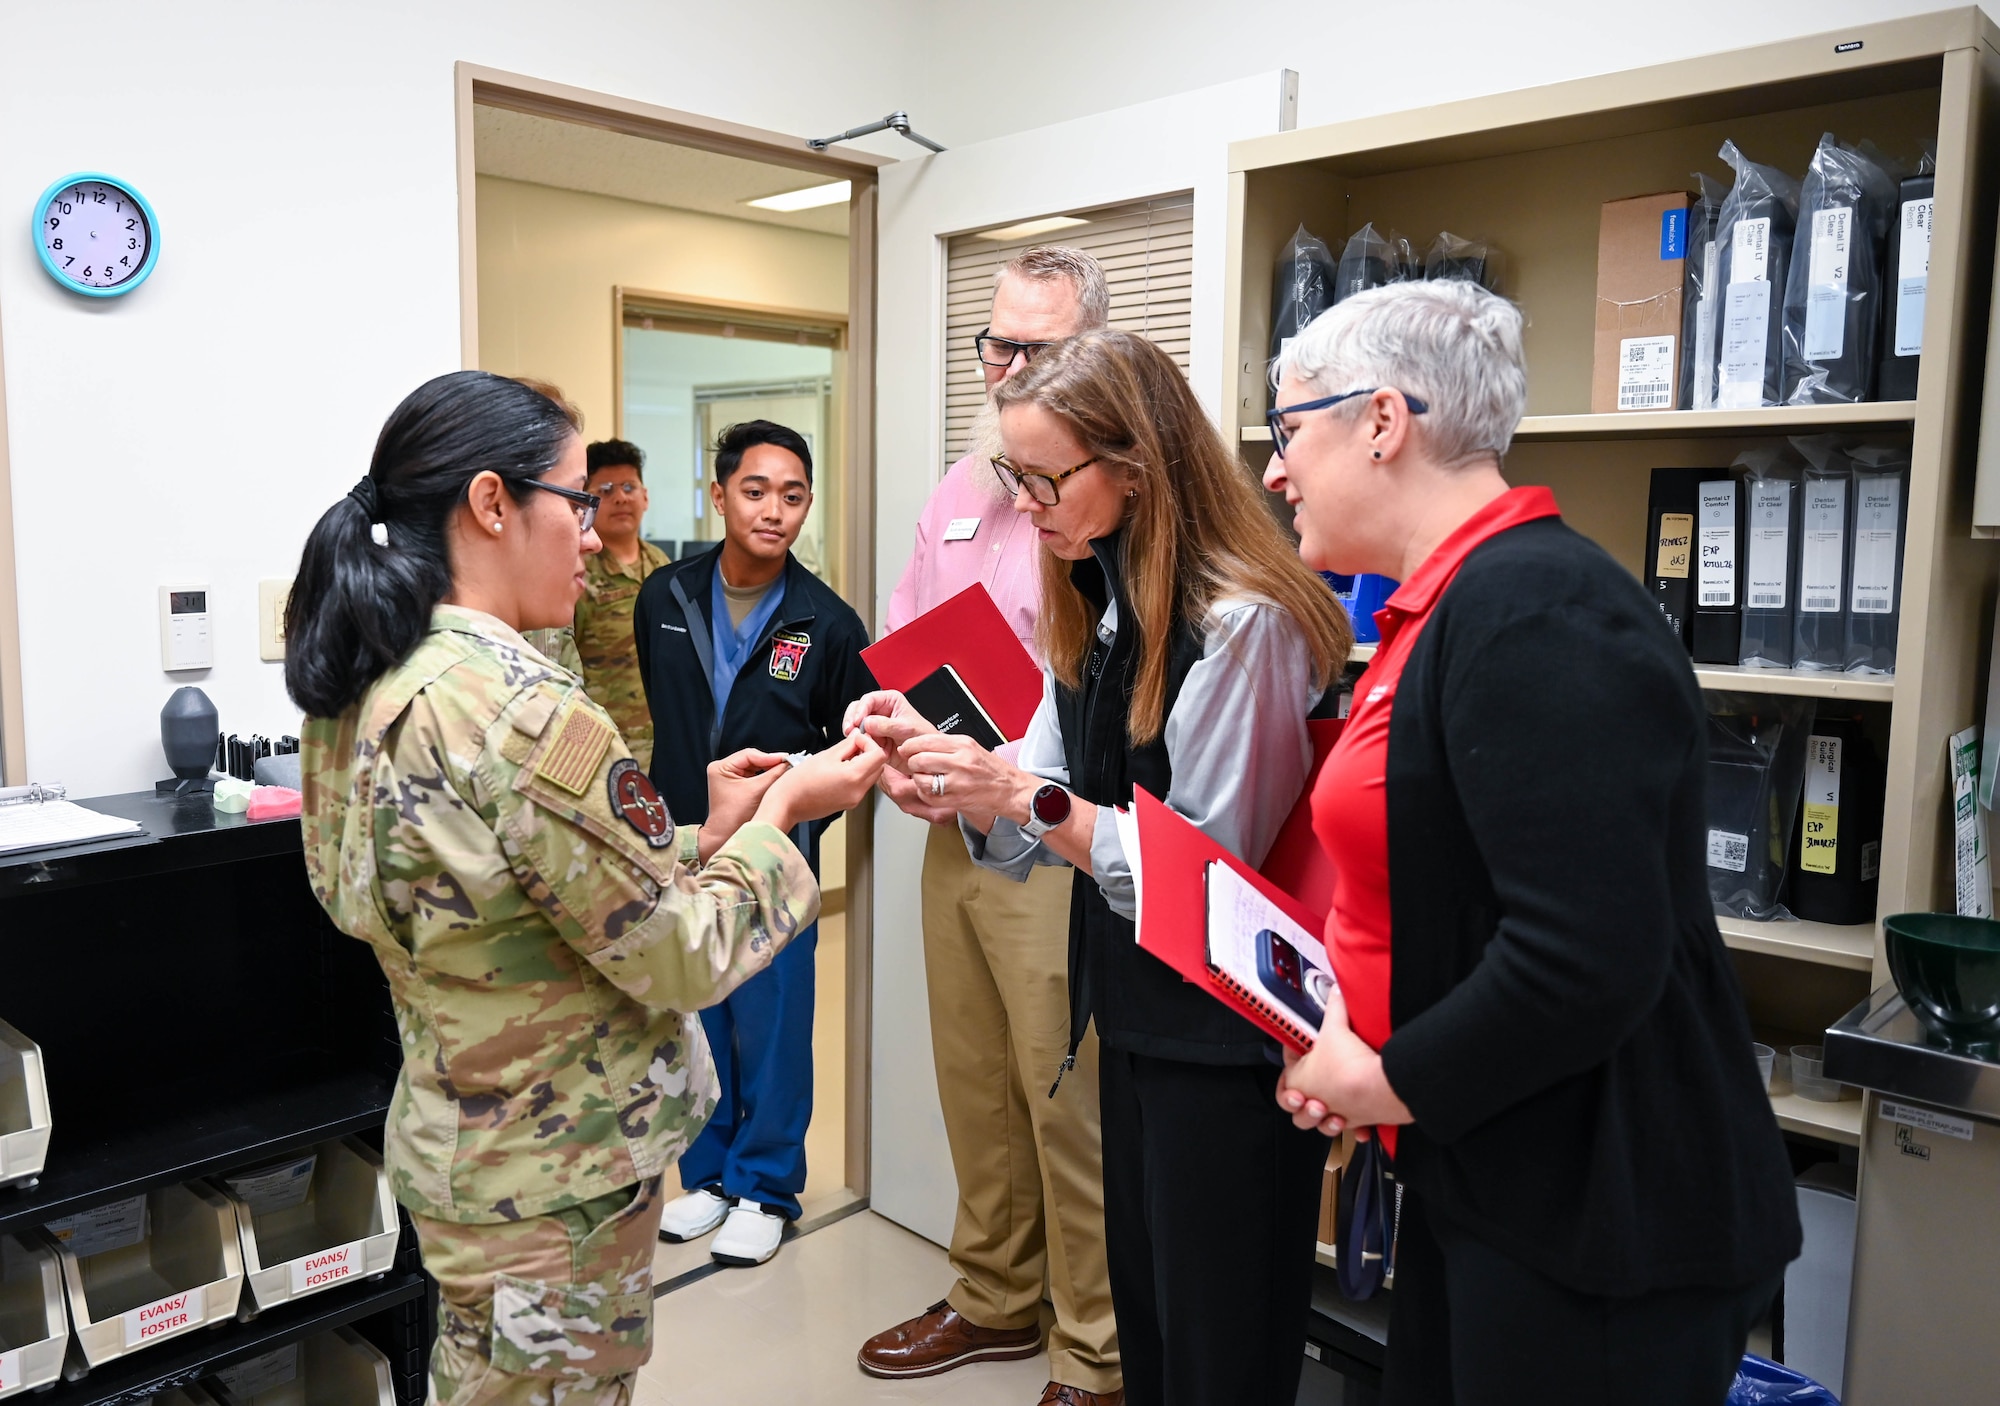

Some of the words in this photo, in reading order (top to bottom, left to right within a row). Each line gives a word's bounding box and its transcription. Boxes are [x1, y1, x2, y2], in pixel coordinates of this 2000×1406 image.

[75, 191, 85, 204] 11
[93, 191, 107, 204] 12
[57, 201, 72, 215] 10
[115, 202, 121, 212] 1
[1906, 206, 1915, 229] Resin
[1917, 204, 1926, 228] Clear
[50, 217, 60, 230] 9
[125, 218, 135, 231] 2
[1827, 214, 1836, 237] Clear
[1836, 213, 1846, 241] Dental
[1756, 223, 1765, 250] Dental
[53, 238, 63, 250] 8
[128, 238, 136, 249] 3
[1836, 244, 1845, 252] LT
[65, 255, 75, 267] 7
[120, 255, 128, 267] 4
[1755, 252, 1762, 261] LT
[83, 265, 92, 277] 6
[104, 266, 114, 277] 5
[1834, 266, 1843, 279] V2
[1703, 545, 1720, 557] EXP
[1670, 553, 1685, 566] EXP
[937, 712, 960, 730] American
[1810, 740, 1818, 760] Resin
[1819, 741, 1827, 764] Guide
[1827, 741, 1836, 773] Surgical
[1826, 791, 1834, 802] V1
[1807, 821, 1824, 833] EXP
[305, 1247, 349, 1272] EVANS/
[306, 1264, 349, 1287] FOSTER
[139, 1294, 188, 1322] EVANS/
[140, 1312, 188, 1339] FOSTER
